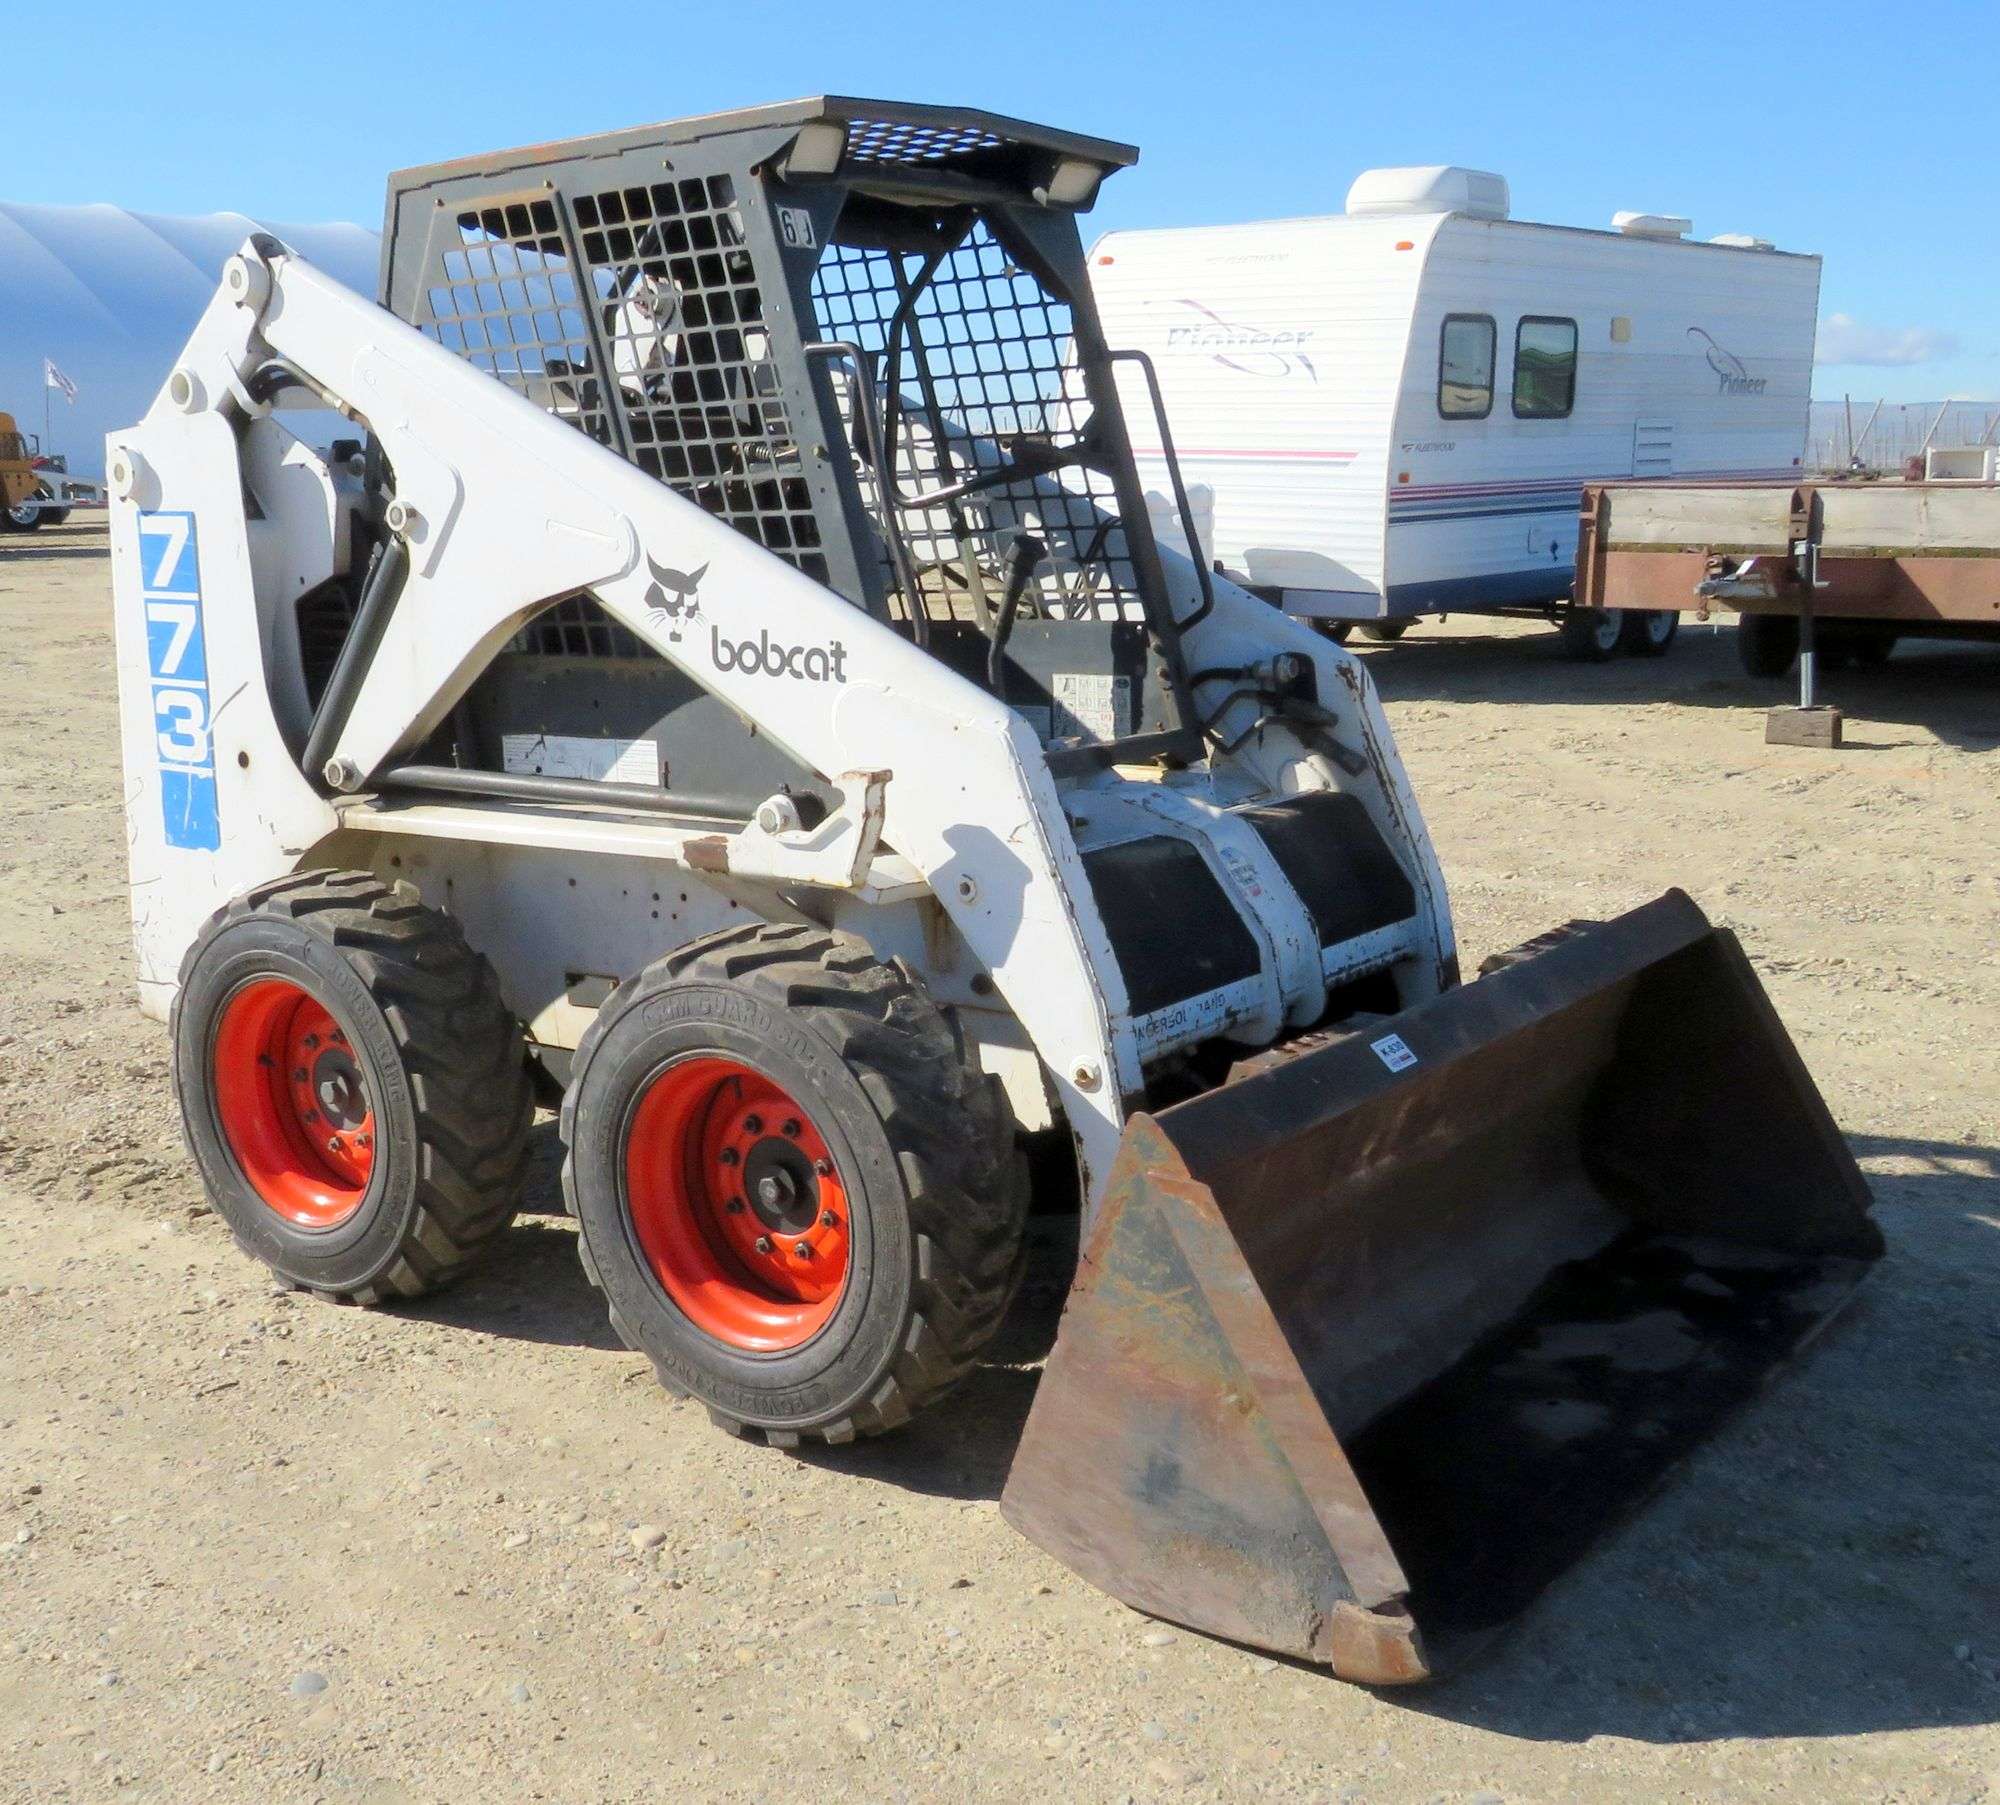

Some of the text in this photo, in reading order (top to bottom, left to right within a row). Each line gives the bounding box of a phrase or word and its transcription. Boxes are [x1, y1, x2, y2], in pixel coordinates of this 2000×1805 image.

[1167, 323, 1315, 349] Pioneer
[1719, 372, 1768, 395] Pioneer
[711, 624, 848, 684] bobcat
